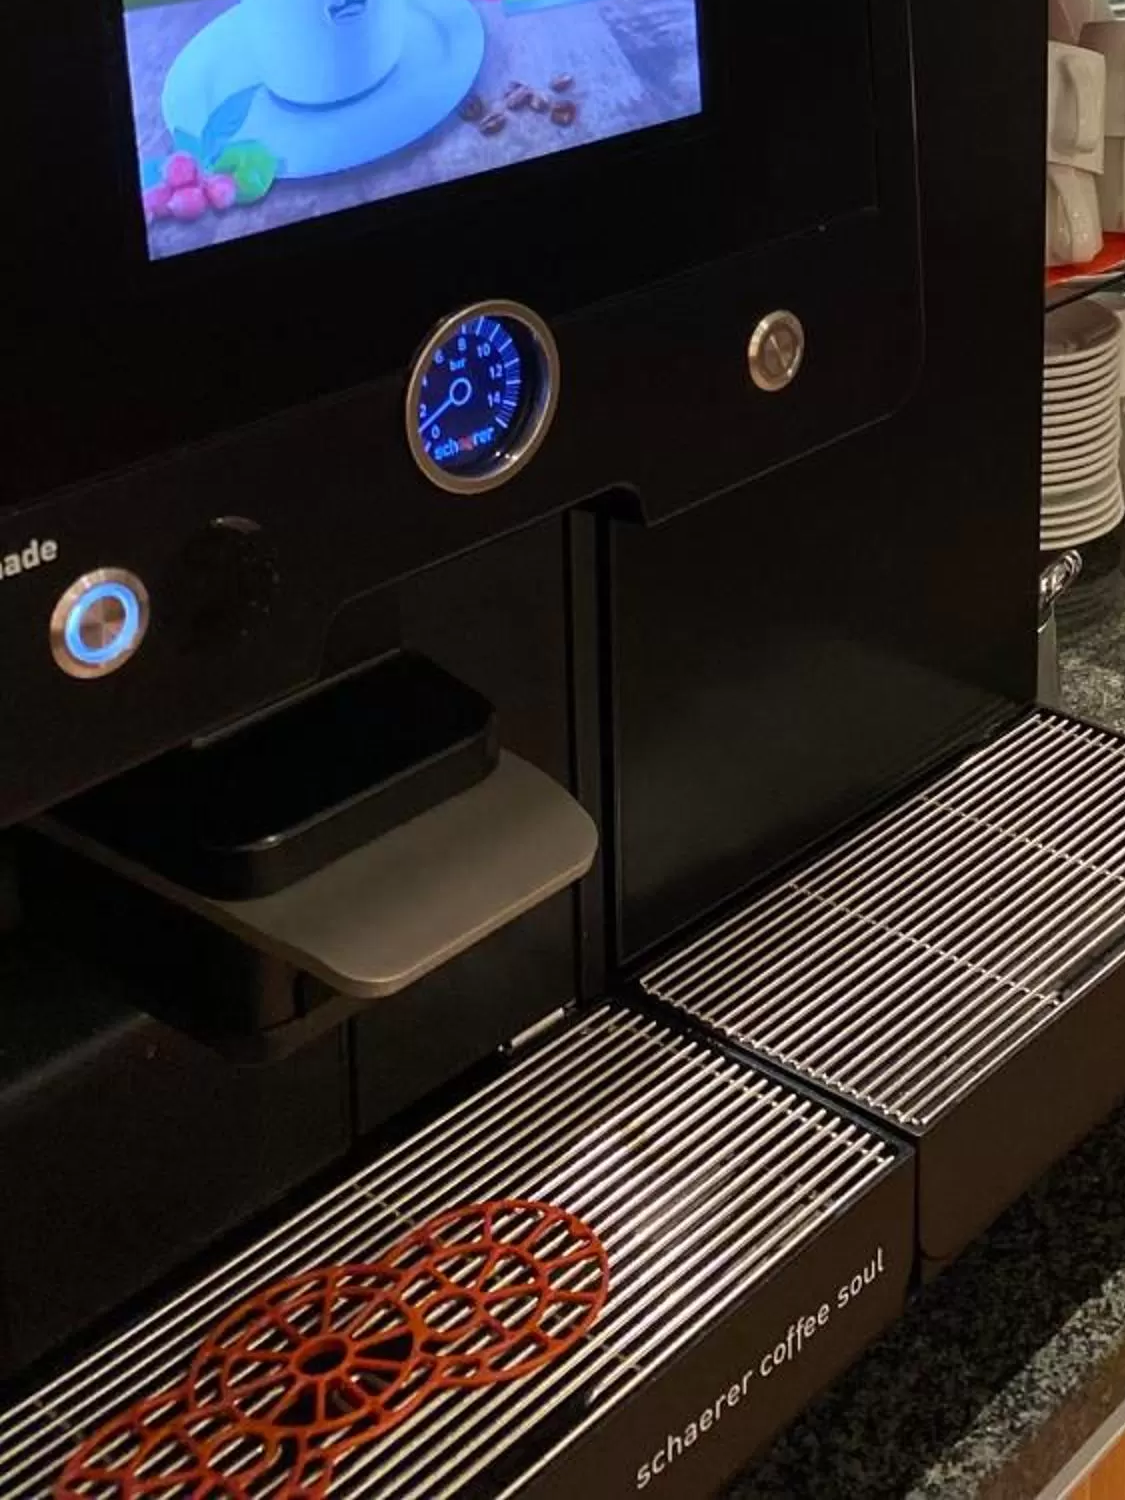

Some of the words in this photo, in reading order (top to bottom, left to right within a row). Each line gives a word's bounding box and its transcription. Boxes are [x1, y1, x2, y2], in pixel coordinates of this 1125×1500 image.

[434, 350, 444, 364] 6
[476, 343, 491, 358] 10
[489, 363, 503, 380] 12
[432, 424, 440, 439] 0
[636, 1368, 752, 1490] schaerer
[760, 1302, 830, 1377] coffee
[837, 1247, 885, 1309] soul
